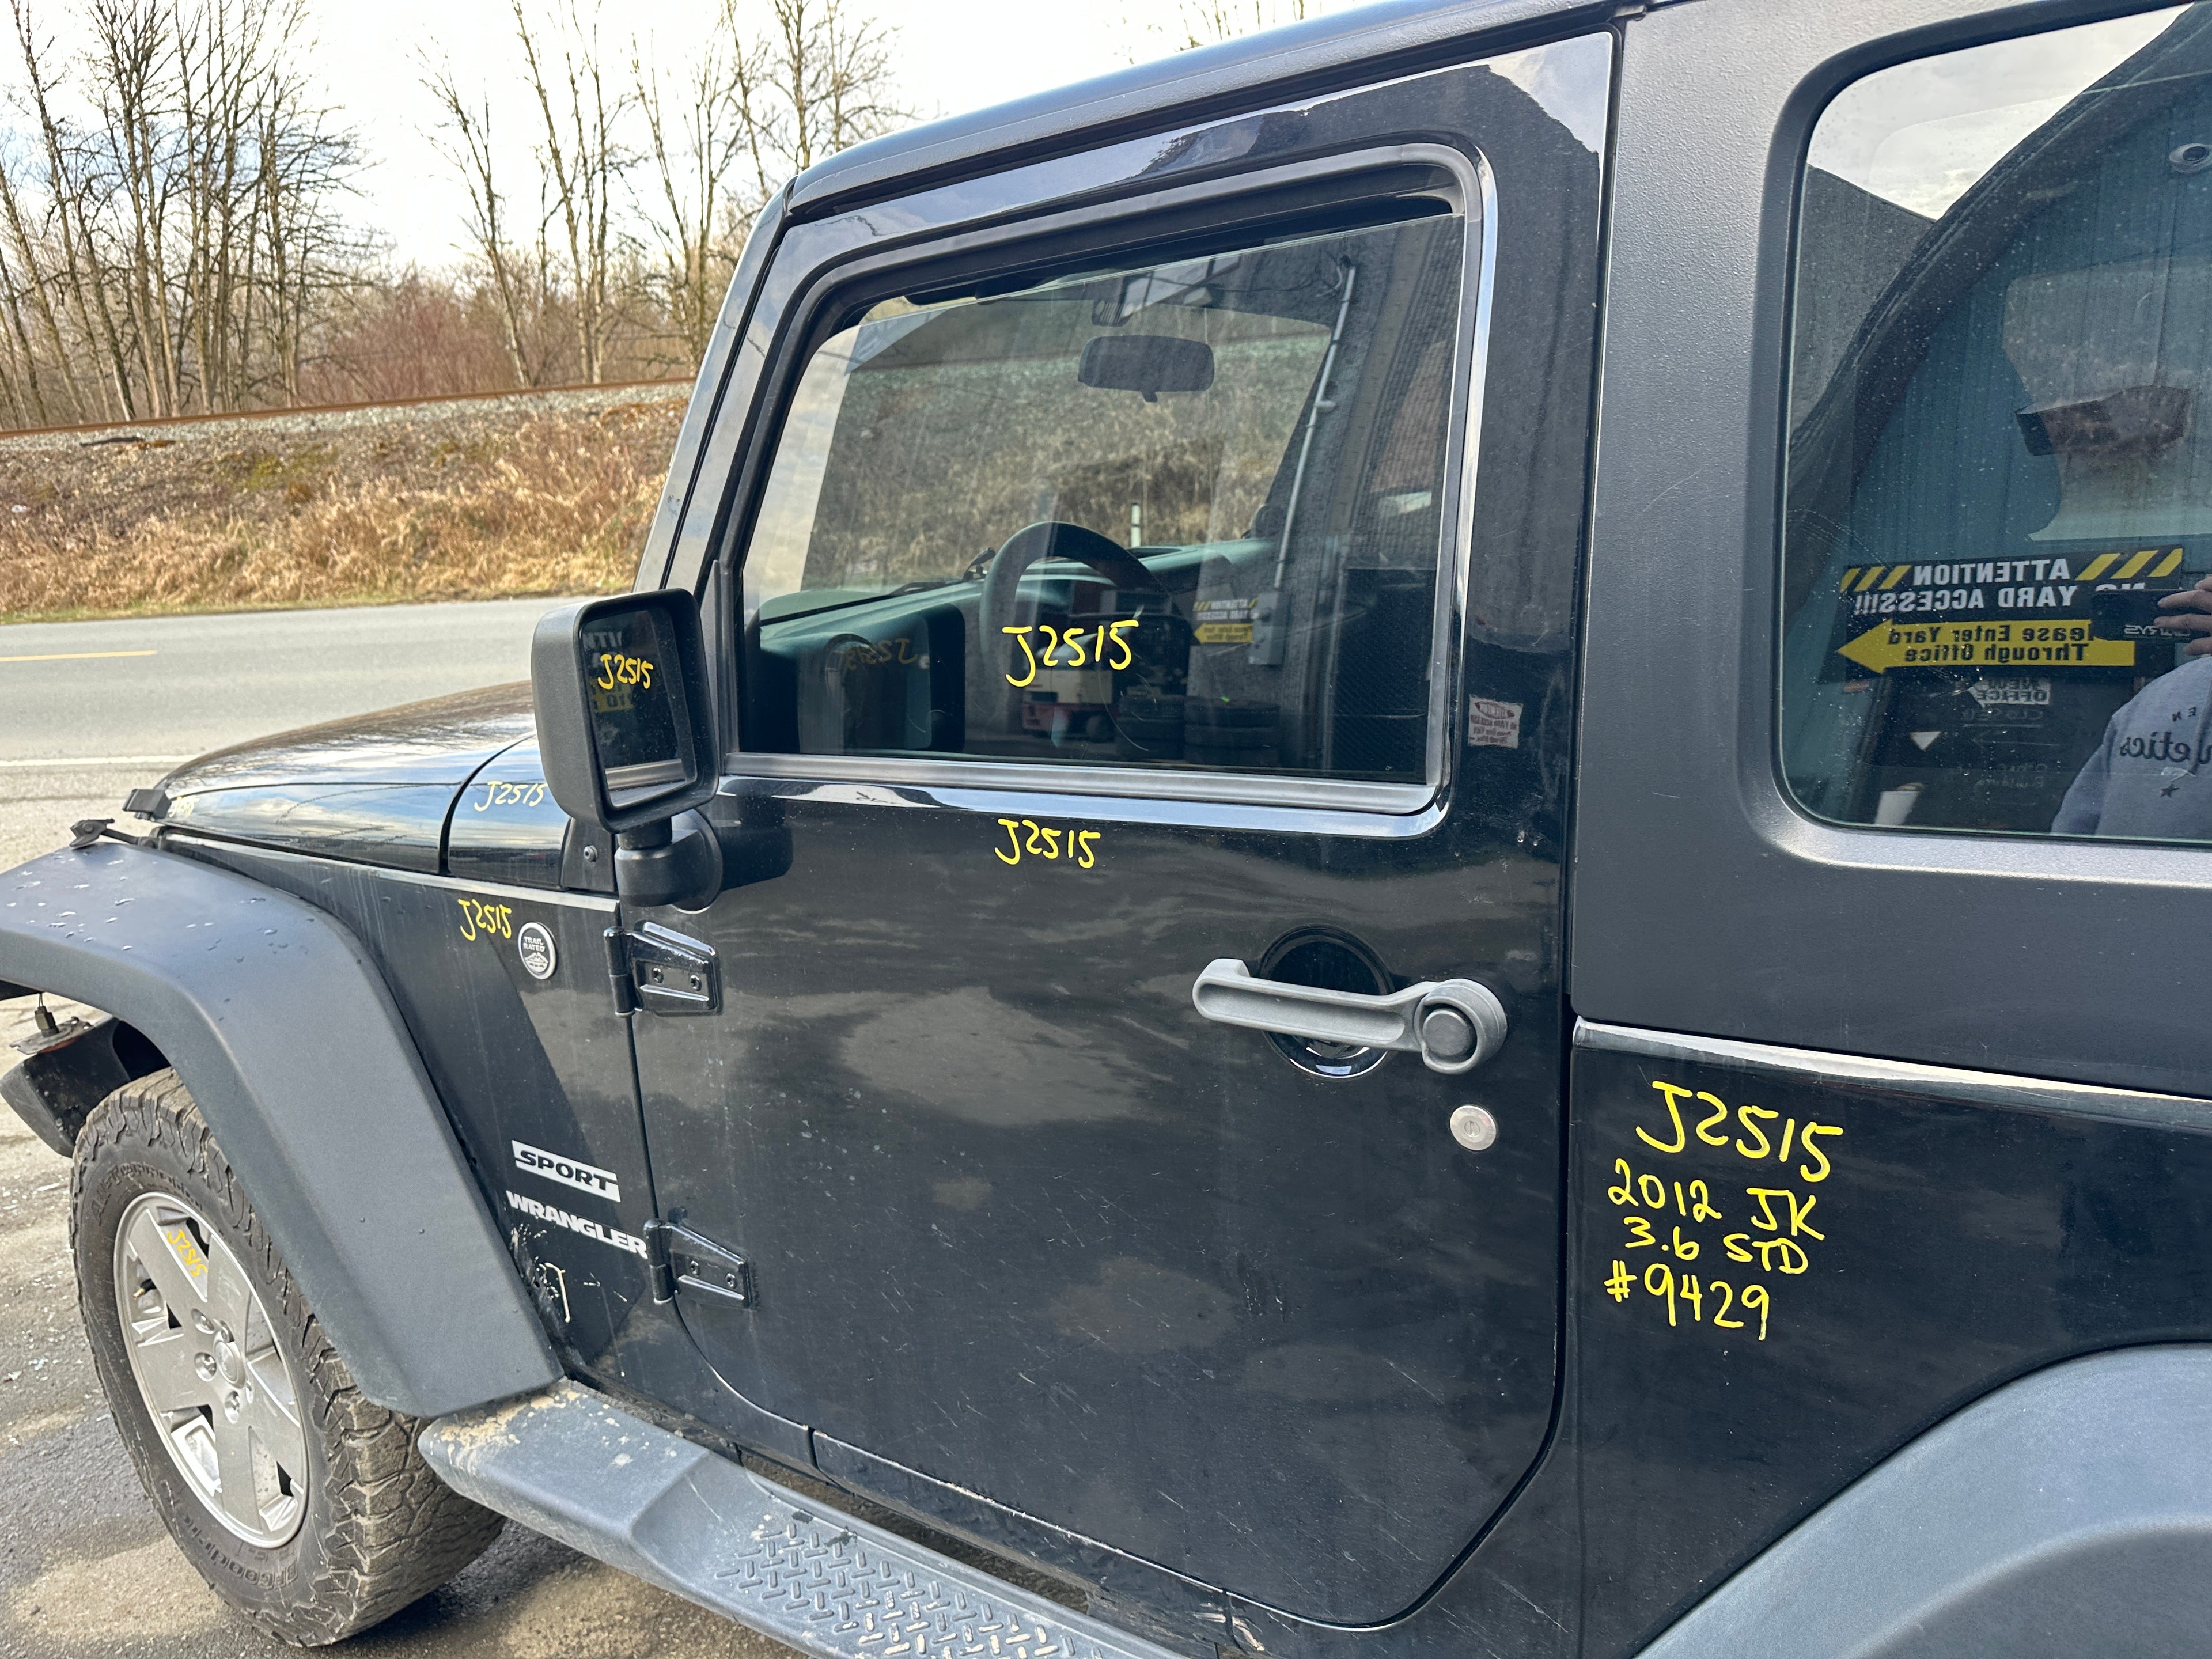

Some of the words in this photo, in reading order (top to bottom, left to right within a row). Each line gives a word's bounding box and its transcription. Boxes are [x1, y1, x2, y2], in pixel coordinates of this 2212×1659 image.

[597, 654, 653, 690] J2515
[1002, 619, 1139, 687] J2515
[474, 781, 548, 812] J2515
[994, 817, 1101, 868] J2515
[458, 899, 512, 941] J2515
[523, 936, 544, 945] TRAIL
[522, 942, 546, 952] RATED
[1635, 1081, 1843, 1182] J2515
[520, 1150, 618, 1191] SPORT
[506, 1190, 648, 1259] WRANGLER
[1608, 1158, 1722, 1222] 2012
[1746, 1188, 1825, 1241] JK
[1623, 1217, 1700, 1260] 3.6
[1723, 1233, 1808, 1274] STD
[1604, 1260, 1770, 1340] #9429
